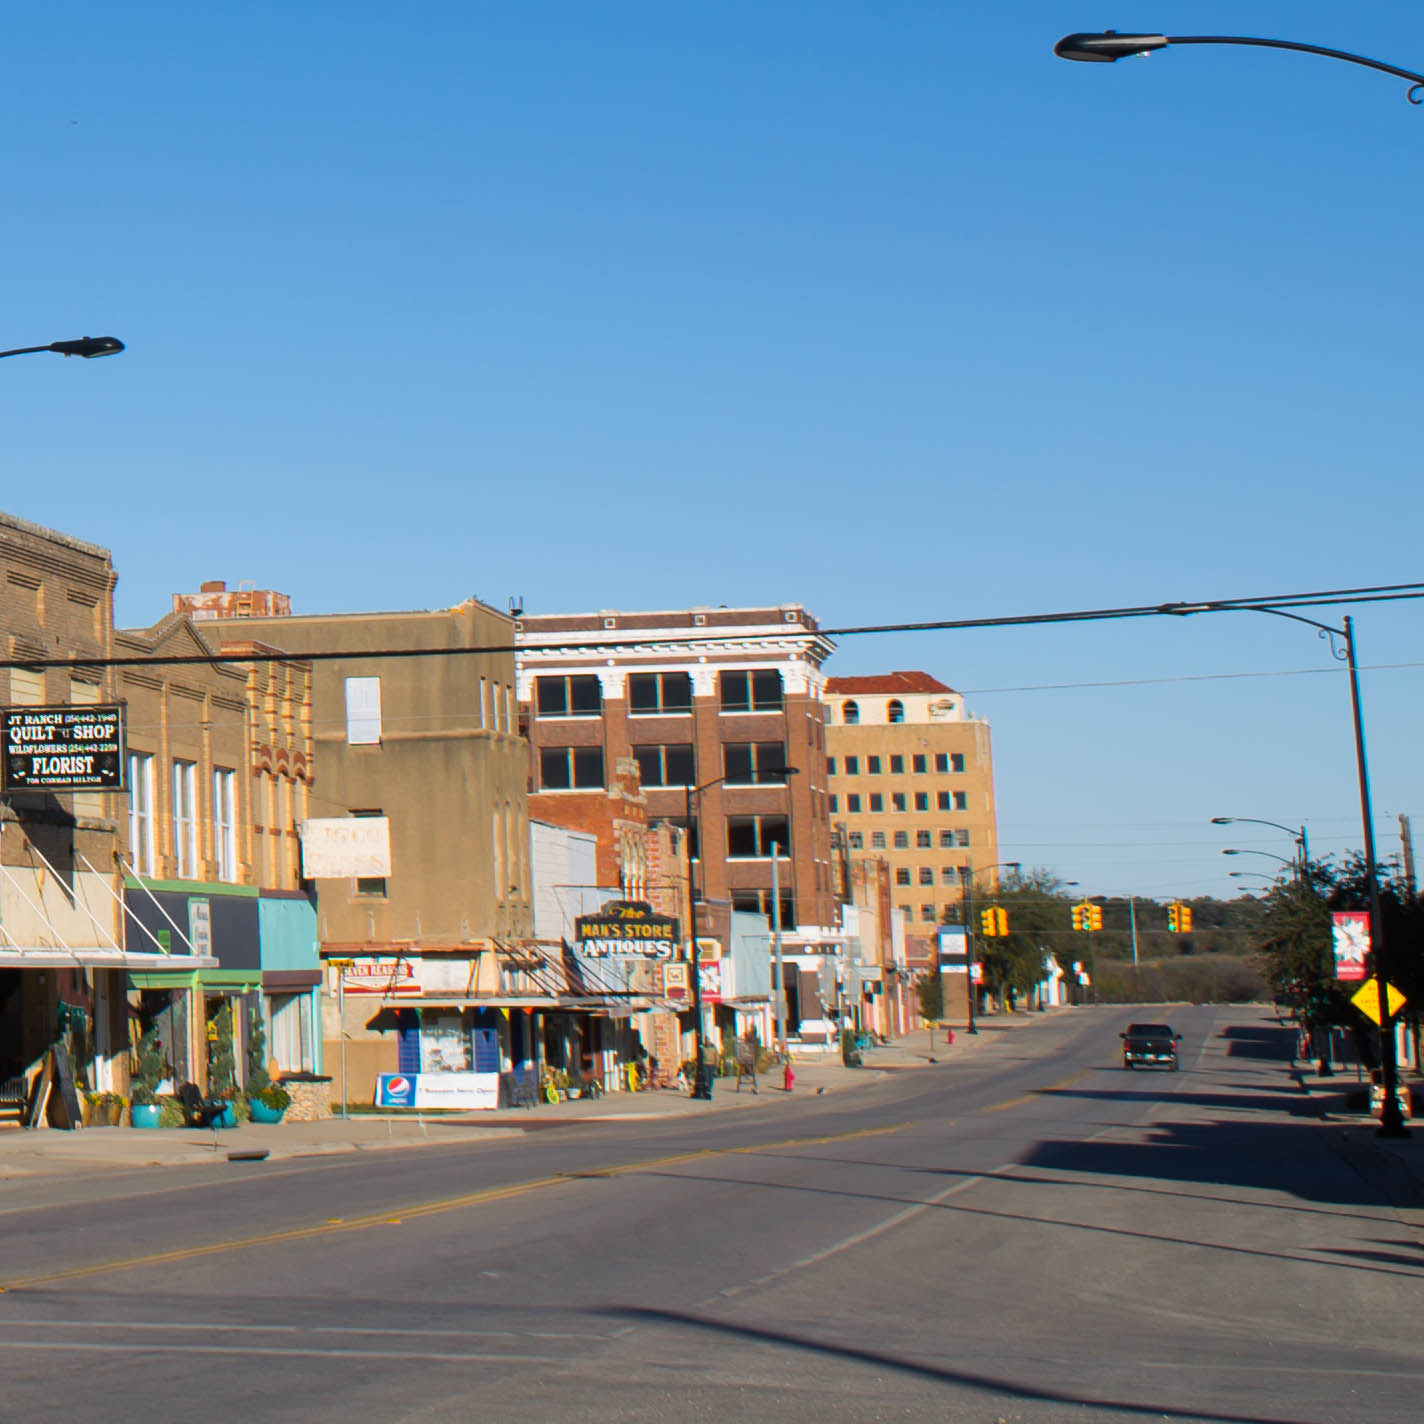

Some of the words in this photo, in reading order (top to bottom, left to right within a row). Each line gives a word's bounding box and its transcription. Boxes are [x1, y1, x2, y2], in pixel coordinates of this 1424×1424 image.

[7, 715, 22, 725] JT
[24, 713, 63, 725] RANCH
[9, 724, 57, 744] QUILT
[72, 724, 115, 739] SHOP
[8, 743, 67, 755] WILDFLOWERS
[31, 755, 95, 775] FLORIST
[581, 923, 621, 937] MAN'S
[625, 923, 673, 937] STORE
[583, 939, 673, 958] ANTIQUES
